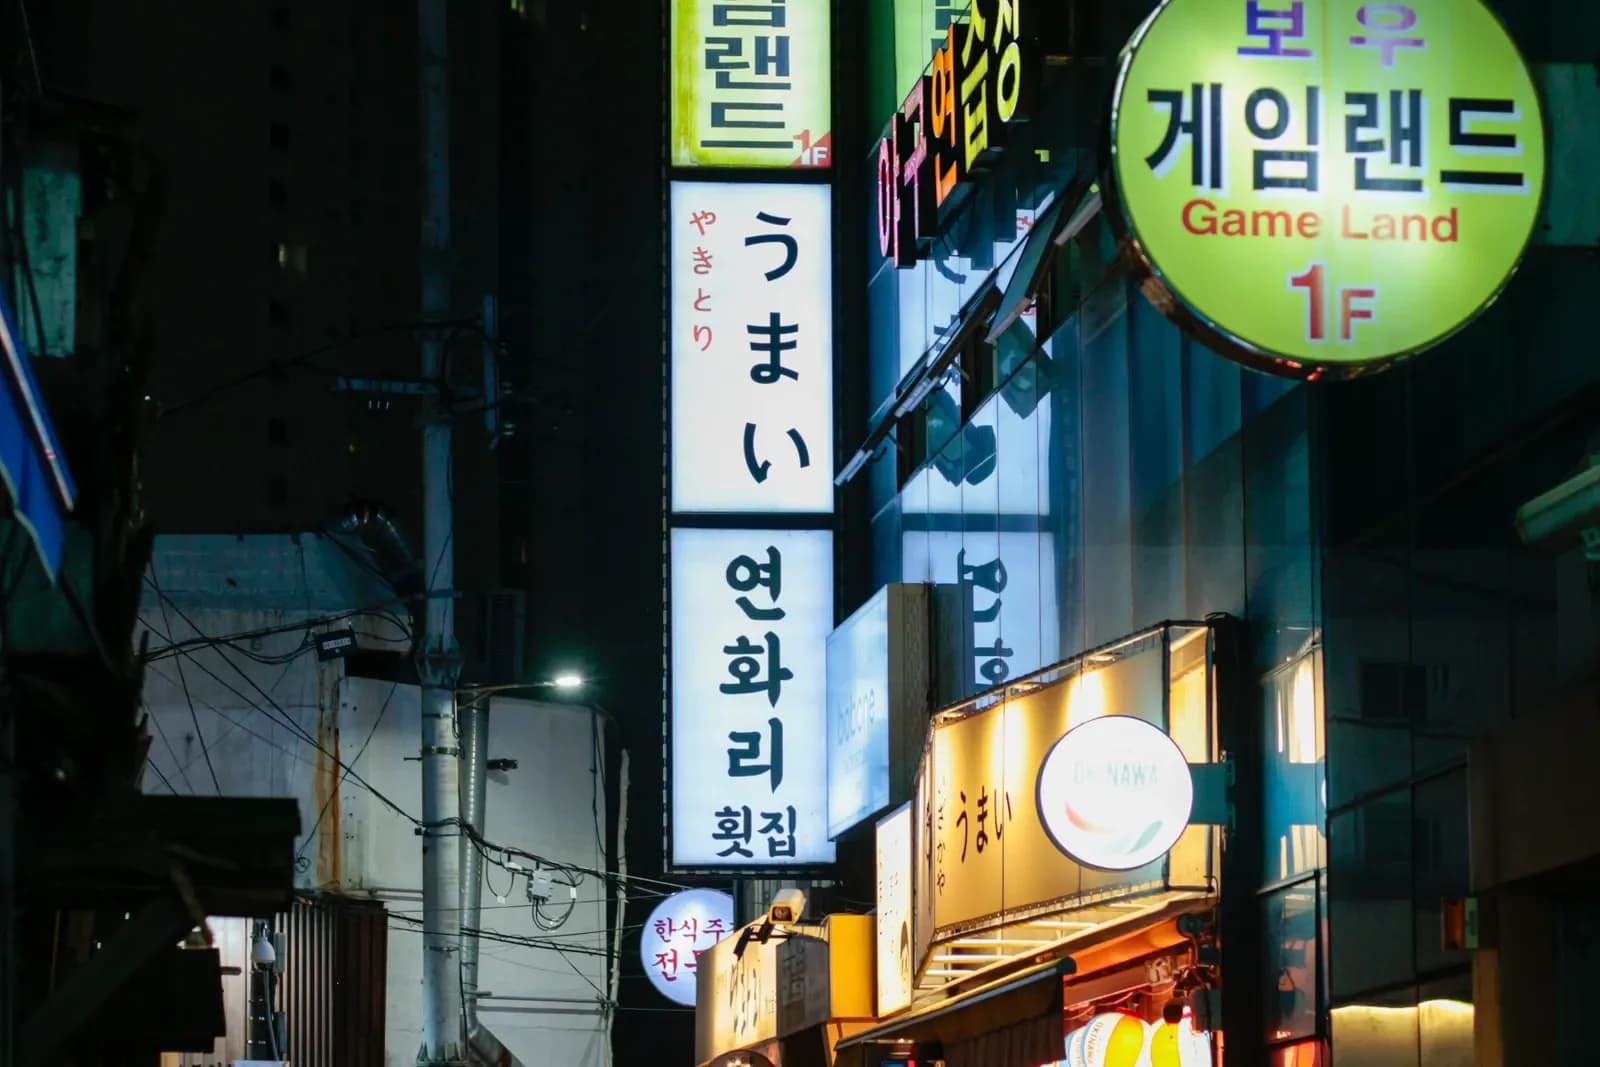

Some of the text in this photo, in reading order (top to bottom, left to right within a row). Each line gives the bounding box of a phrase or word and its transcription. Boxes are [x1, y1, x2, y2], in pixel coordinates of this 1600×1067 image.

[1237, 0, 1426, 67] 보우
[793, 129, 828, 167] 1F
[1145, 83, 1525, 193] 게임랜드
[1181, 199, 1459, 244] Game Land
[689, 209, 717, 352] やきとり
[1290, 263, 1376, 341] 1F
[742, 210, 811, 485] うまい
[718, 545, 795, 795] 연화리
[711, 805, 798, 859] 횟집
[956, 785, 1012, 864] うまい
